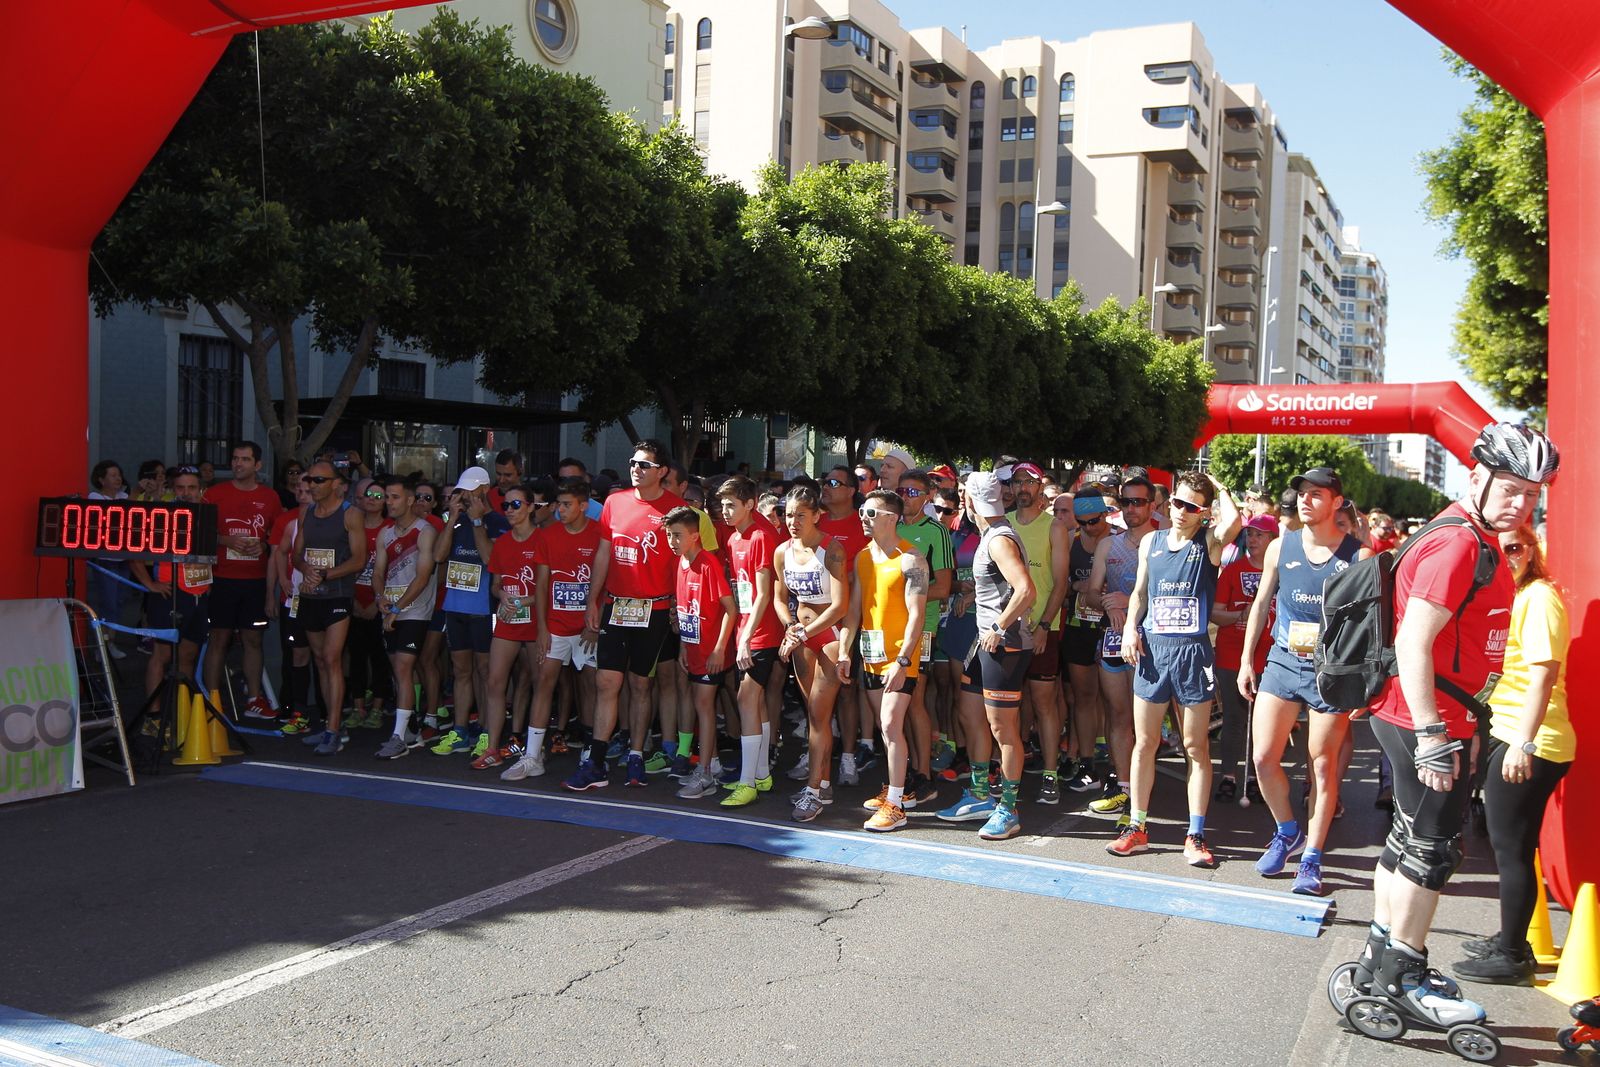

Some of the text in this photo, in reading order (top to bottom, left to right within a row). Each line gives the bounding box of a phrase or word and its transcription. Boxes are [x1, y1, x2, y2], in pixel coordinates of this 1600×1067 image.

[1266, 392, 1378, 411] Santander
[187, 568, 208, 579] 3311
[450, 570, 474, 582] 3167
[787, 580, 814, 591] 2041
[556, 590, 585, 601] 2139
[1295, 593, 1324, 602] DEHAR
[616, 606, 645, 617] 3238
[1155, 607, 1191, 620] 2245
